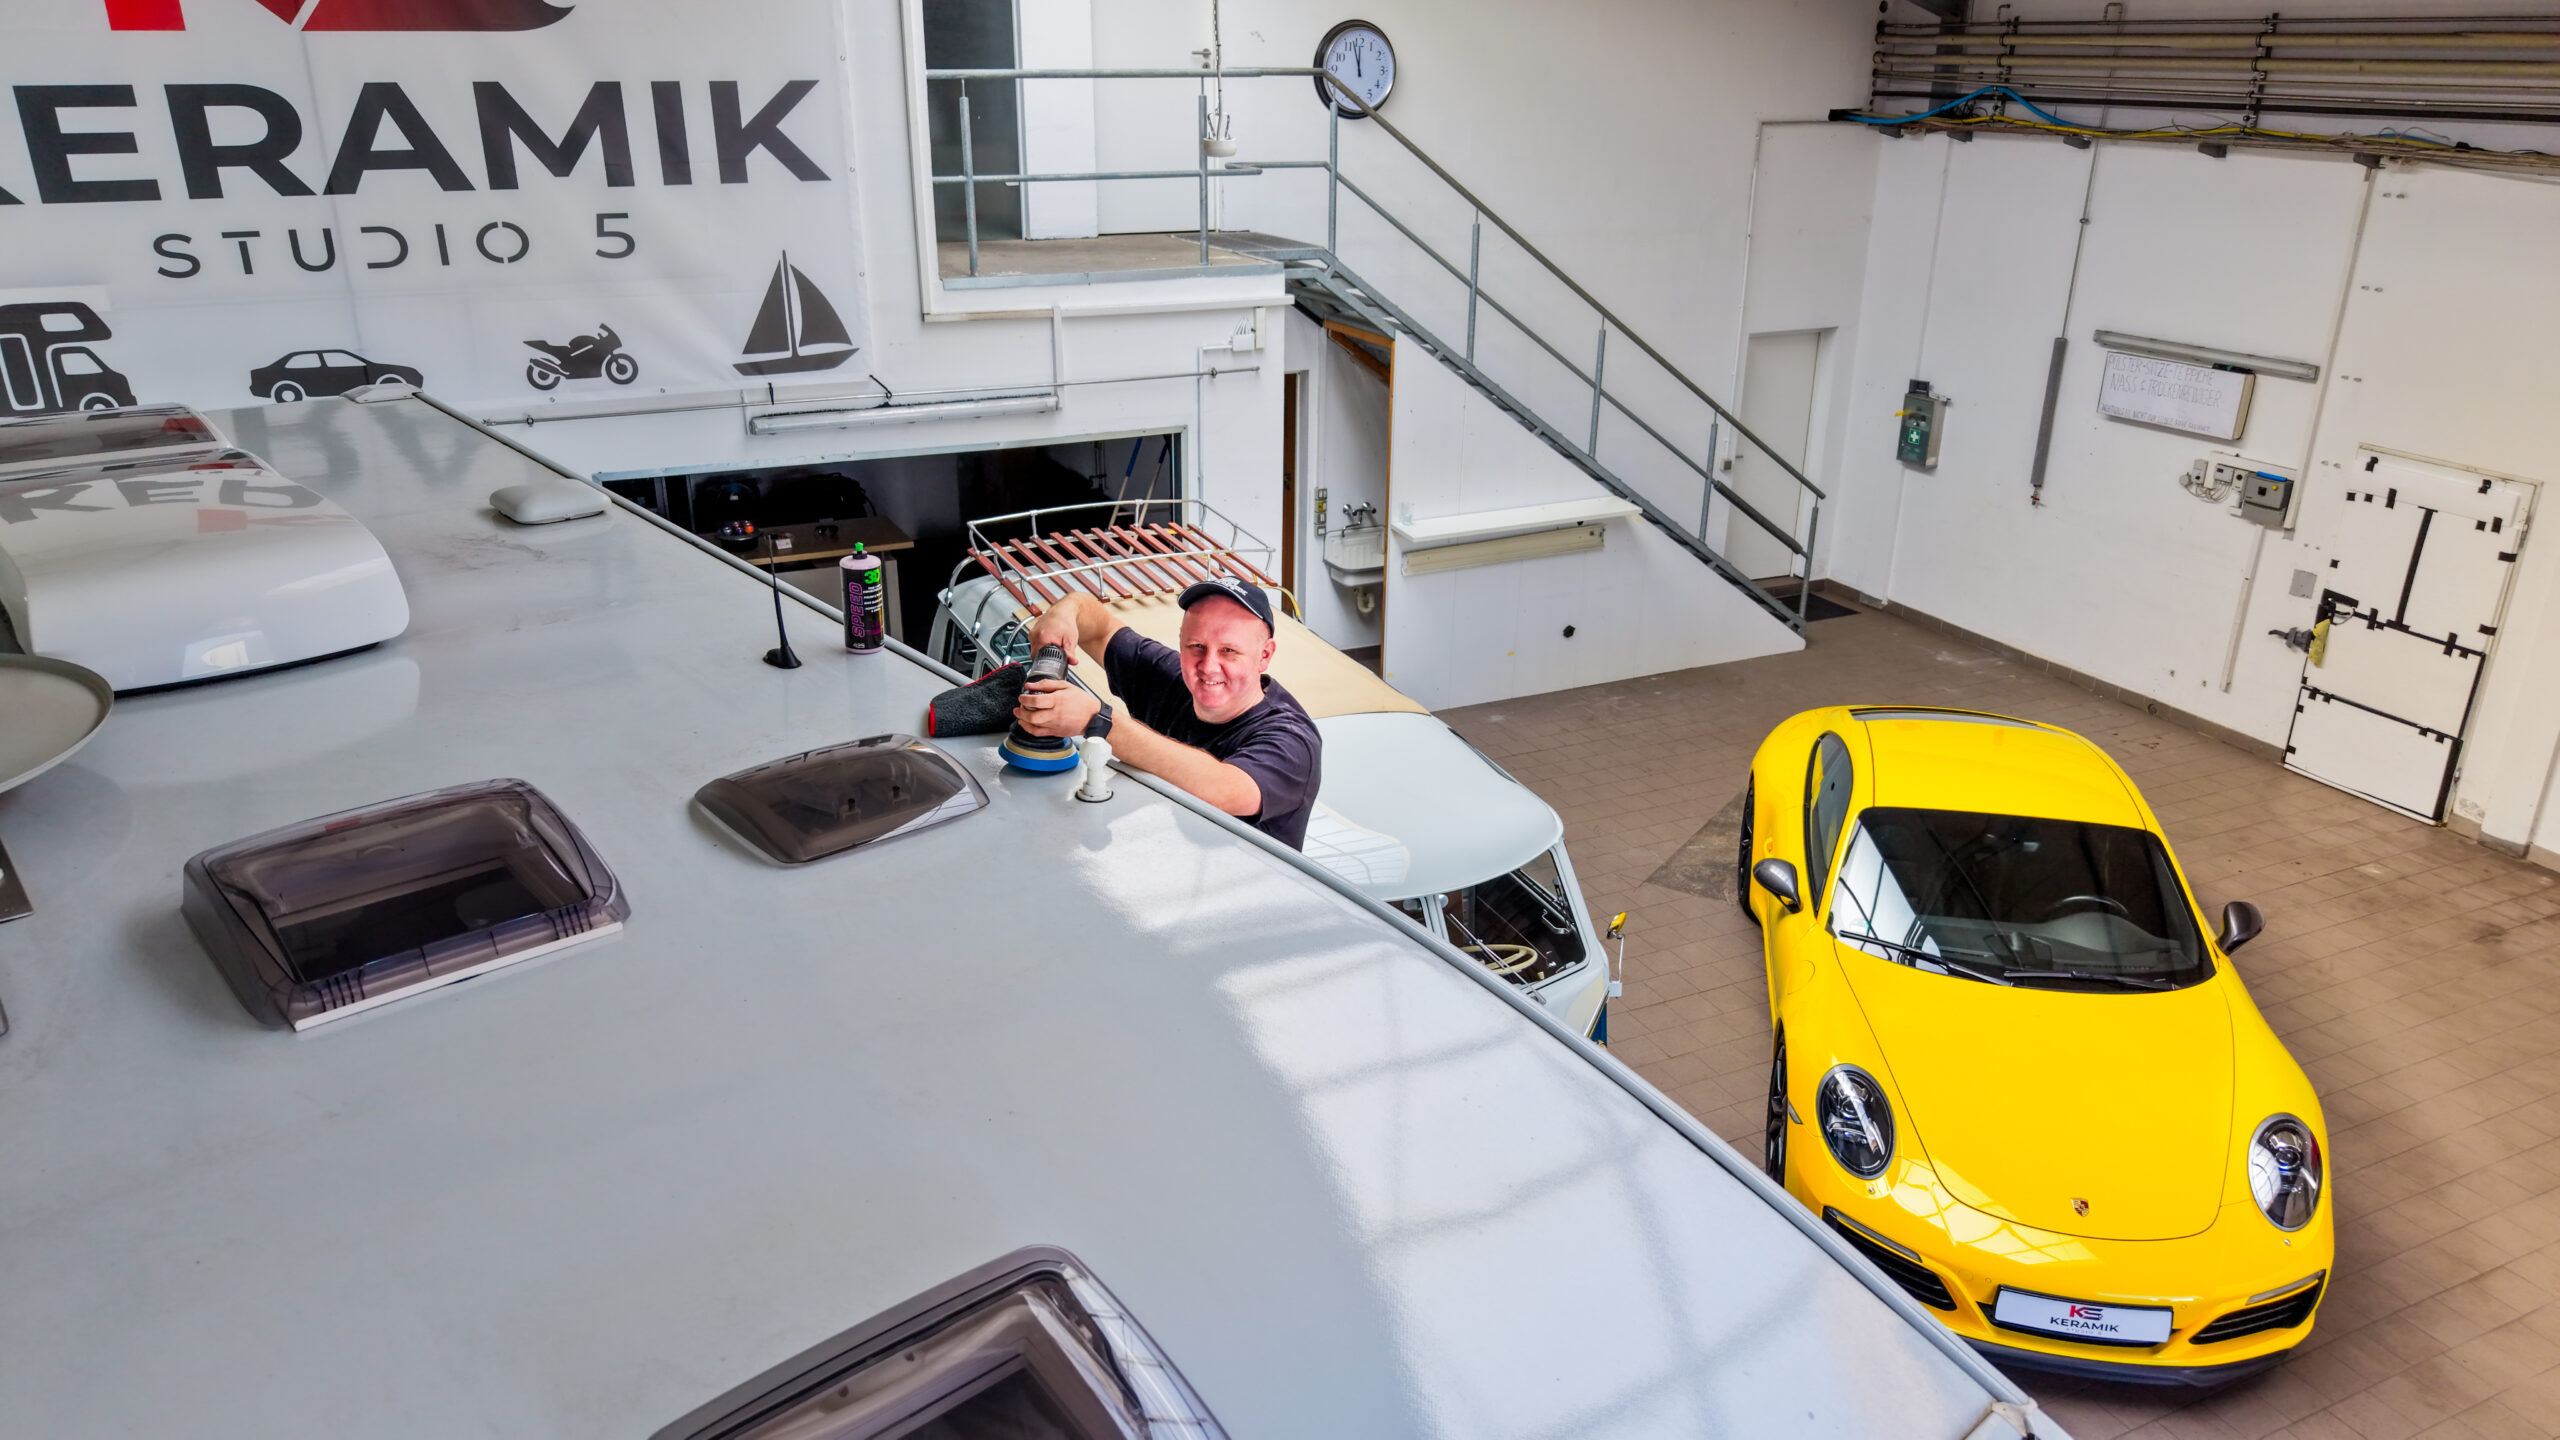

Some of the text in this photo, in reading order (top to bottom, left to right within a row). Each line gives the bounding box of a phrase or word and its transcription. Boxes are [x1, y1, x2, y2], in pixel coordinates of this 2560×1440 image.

[1345, 42, 1352, 52] 11
[1336, 53, 1345, 62] 10
[1376, 51, 1382, 61] 2
[1380, 65, 1386, 76] 3
[1374, 79, 1381, 89] 4
[1367, 88, 1373, 99] 5
[0, 79, 832, 206] ERAMIK
[153, 212, 636, 279] STUDIO 5
[849, 582, 865, 637] SPEED
[2050, 1316, 2119, 1333] KERAMIK
